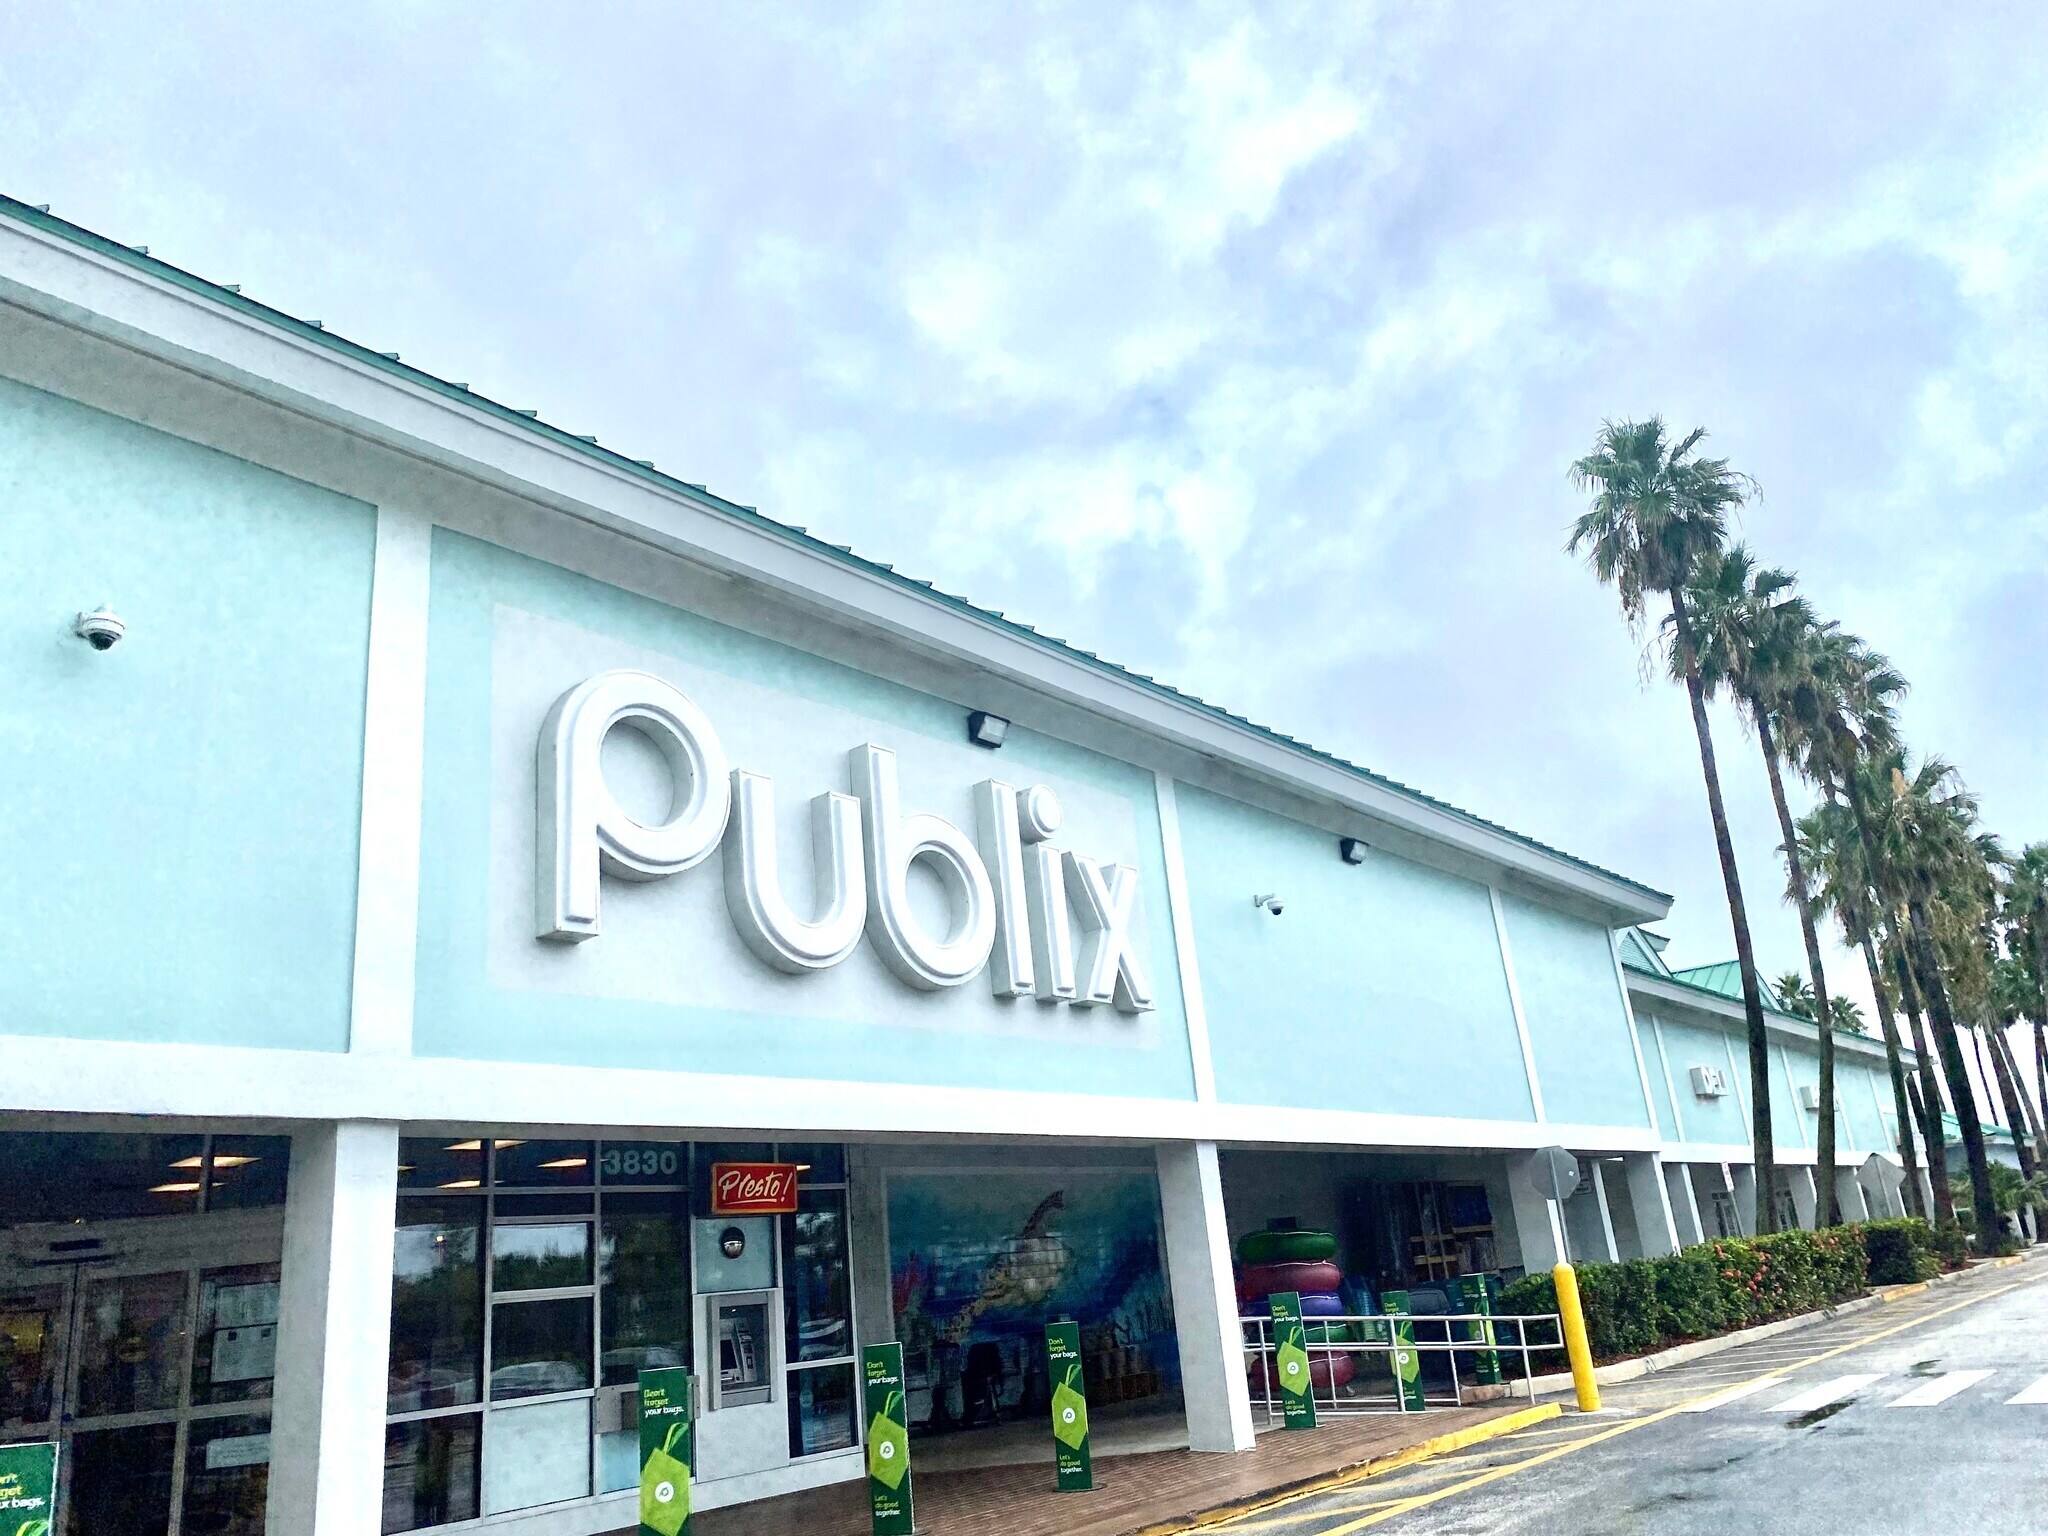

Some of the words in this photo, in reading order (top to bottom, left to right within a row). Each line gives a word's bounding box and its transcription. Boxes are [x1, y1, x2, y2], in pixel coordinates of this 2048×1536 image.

[536, 671, 1154, 1014] Publix
[604, 1149, 678, 1175] 3830
[718, 1170, 793, 1202] Presto!
[1049, 1345, 1066, 1353] forget
[868, 1378, 881, 1387] your
